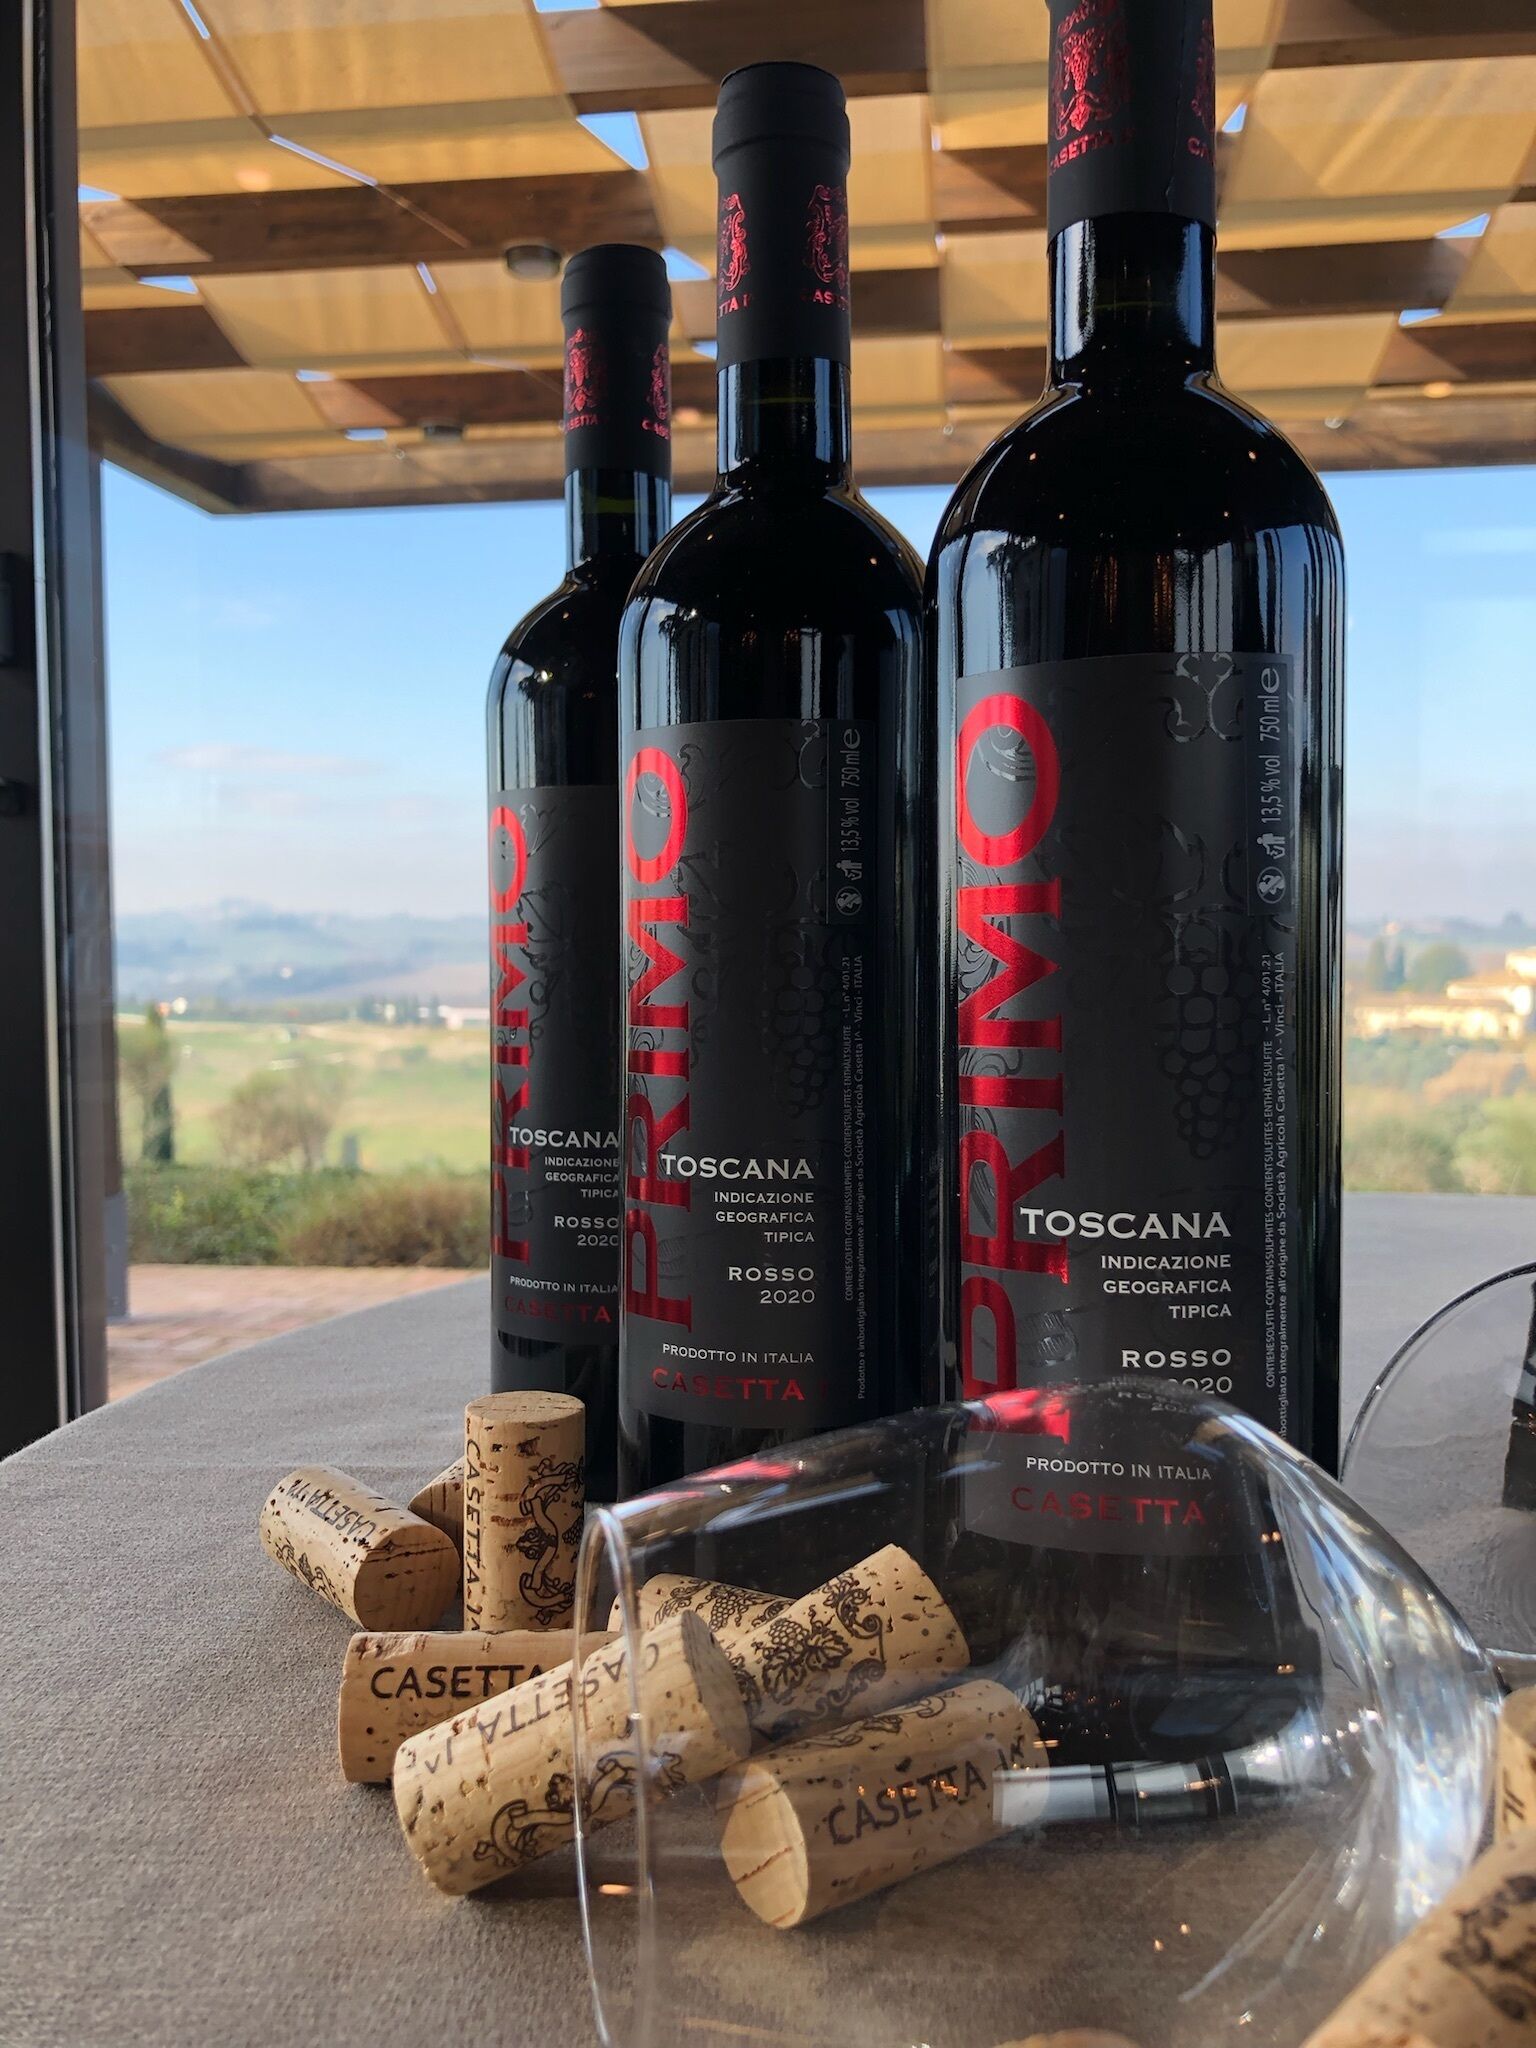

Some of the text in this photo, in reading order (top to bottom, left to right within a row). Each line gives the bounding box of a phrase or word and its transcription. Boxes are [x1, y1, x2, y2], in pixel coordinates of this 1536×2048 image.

[1259, 715, 1280, 742] 750
[841, 766, 860, 788] 750
[1258, 755, 1280, 776] vol
[1260, 779, 1281, 792] %
[840, 797, 860, 816] vol
[1261, 796, 1284, 824] 13,5
[841, 817, 860, 829] %
[840, 829, 862, 853] 13,5
[841, 957, 851, 991] 4/01.21
[853, 955, 862, 988] ITALIA
[1261, 953, 1272, 996] 4/01.21
[1274, 952, 1285, 993] ITALIA
[853, 996, 863, 1022] Vinci
[1275, 1003, 1285, 1037] Vinci
[489, 804, 531, 1267] PRIMO
[624, 746, 692, 1334] PRIMO
[854, 1043, 864, 1082] Casetta
[957, 693, 1069, 1445] PRIMO
[1275, 1063, 1286, 1113] Casetta
[855, 1084, 866, 1127] Agricola
[509, 1126, 619, 1149] TOSCANA
[855, 1129, 865, 1167] Società
[1275, 1115, 1288, 1168] Agricola
[544, 1156, 619, 1168] INDICAZIONE
[661, 1153, 815, 1180] TOSCANA
[856, 1168, 866, 1180] da
[545, 1171, 619, 1183] GEOGRAFICA
[580, 1188, 619, 1199] TIPICA
[714, 1191, 815, 1204] INDICAZIONE
[1276, 1171, 1287, 1219] Società
[715, 1211, 815, 1224] GEOGRAFICA
[1019, 1206, 1232, 1240] TOSCANA
[1276, 1221, 1287, 1236] da
[764, 1231, 815, 1243] TIPICA
[727, 1266, 815, 1282] ROSSO
[1101, 1254, 1232, 1270] INDICAZIONE
[510, 1275, 619, 1294] PRODOTTO IN ITALIA
[759, 1289, 815, 1305] 2020
[1102, 1279, 1232, 1295] GEOGRAFICA
[505, 1295, 613, 1325] CASETTA
[1168, 1303, 1232, 1319] TIPICA
[1278, 1295, 1289, 1374] integralmente
[662, 1343, 815, 1363] PRODOTTO IN ITALIA
[1121, 1348, 1232, 1369] ROSSO
[652, 1366, 805, 1401] CASETTA
[857, 1359, 866, 1400] Prodotto
[1026, 1456, 1212, 1481] PRODOTTO IN ITALIA
[304, 1488, 378, 1539] CASETTA
[465, 1437, 482, 1584] CASETTA
[1011, 1486, 1205, 1526] CASETTA
[477, 1642, 660, 1745] CASETTA
[827, 1759, 987, 1846] CASETTA
